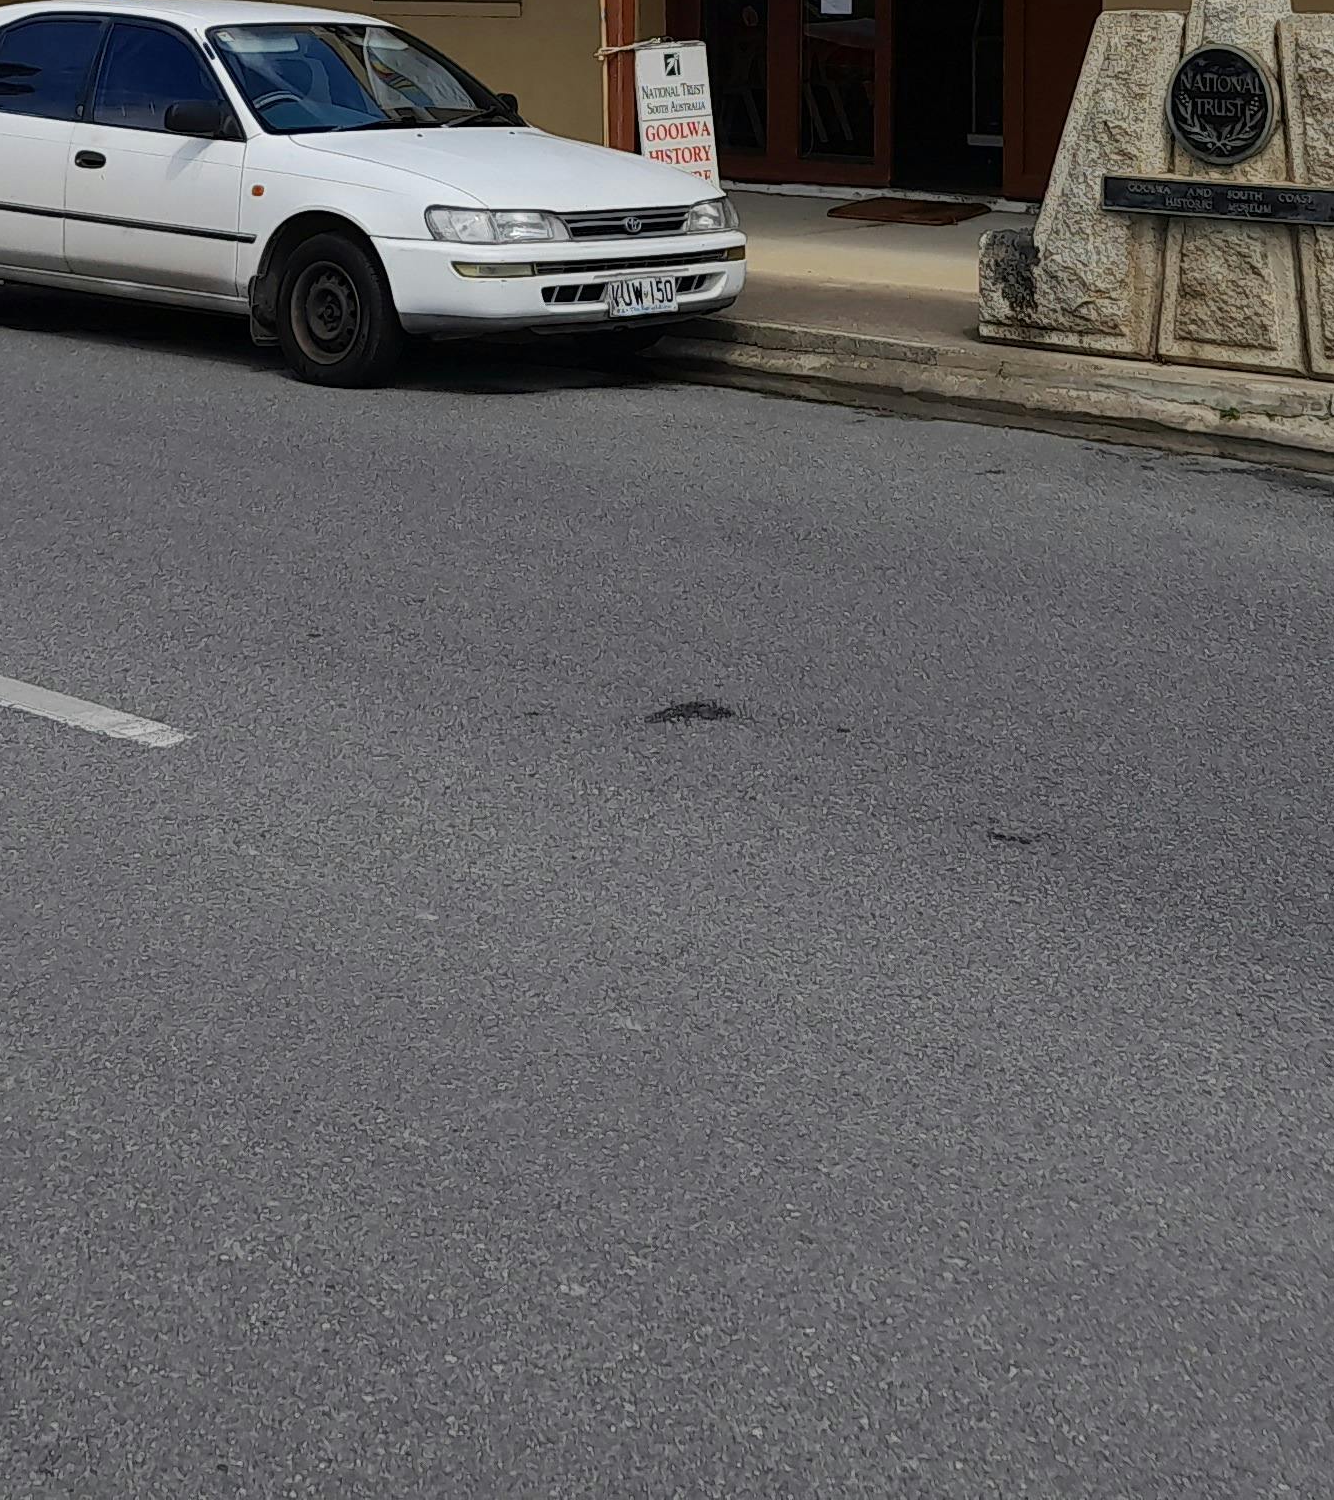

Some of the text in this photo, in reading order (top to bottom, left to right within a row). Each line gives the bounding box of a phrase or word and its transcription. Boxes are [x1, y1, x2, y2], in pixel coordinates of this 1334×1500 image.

[1180, 68, 1264, 95] NATIONAL
[642, 82, 705, 100] NATIONAL TRUST
[647, 100, 706, 115] SOUTH AUSTRALIA
[1194, 98, 1244, 117] TRUST
[645, 120, 711, 142] GOOLWA
[1186, 187, 1213, 199] AND
[1226, 189, 1264, 202] SOUTH
